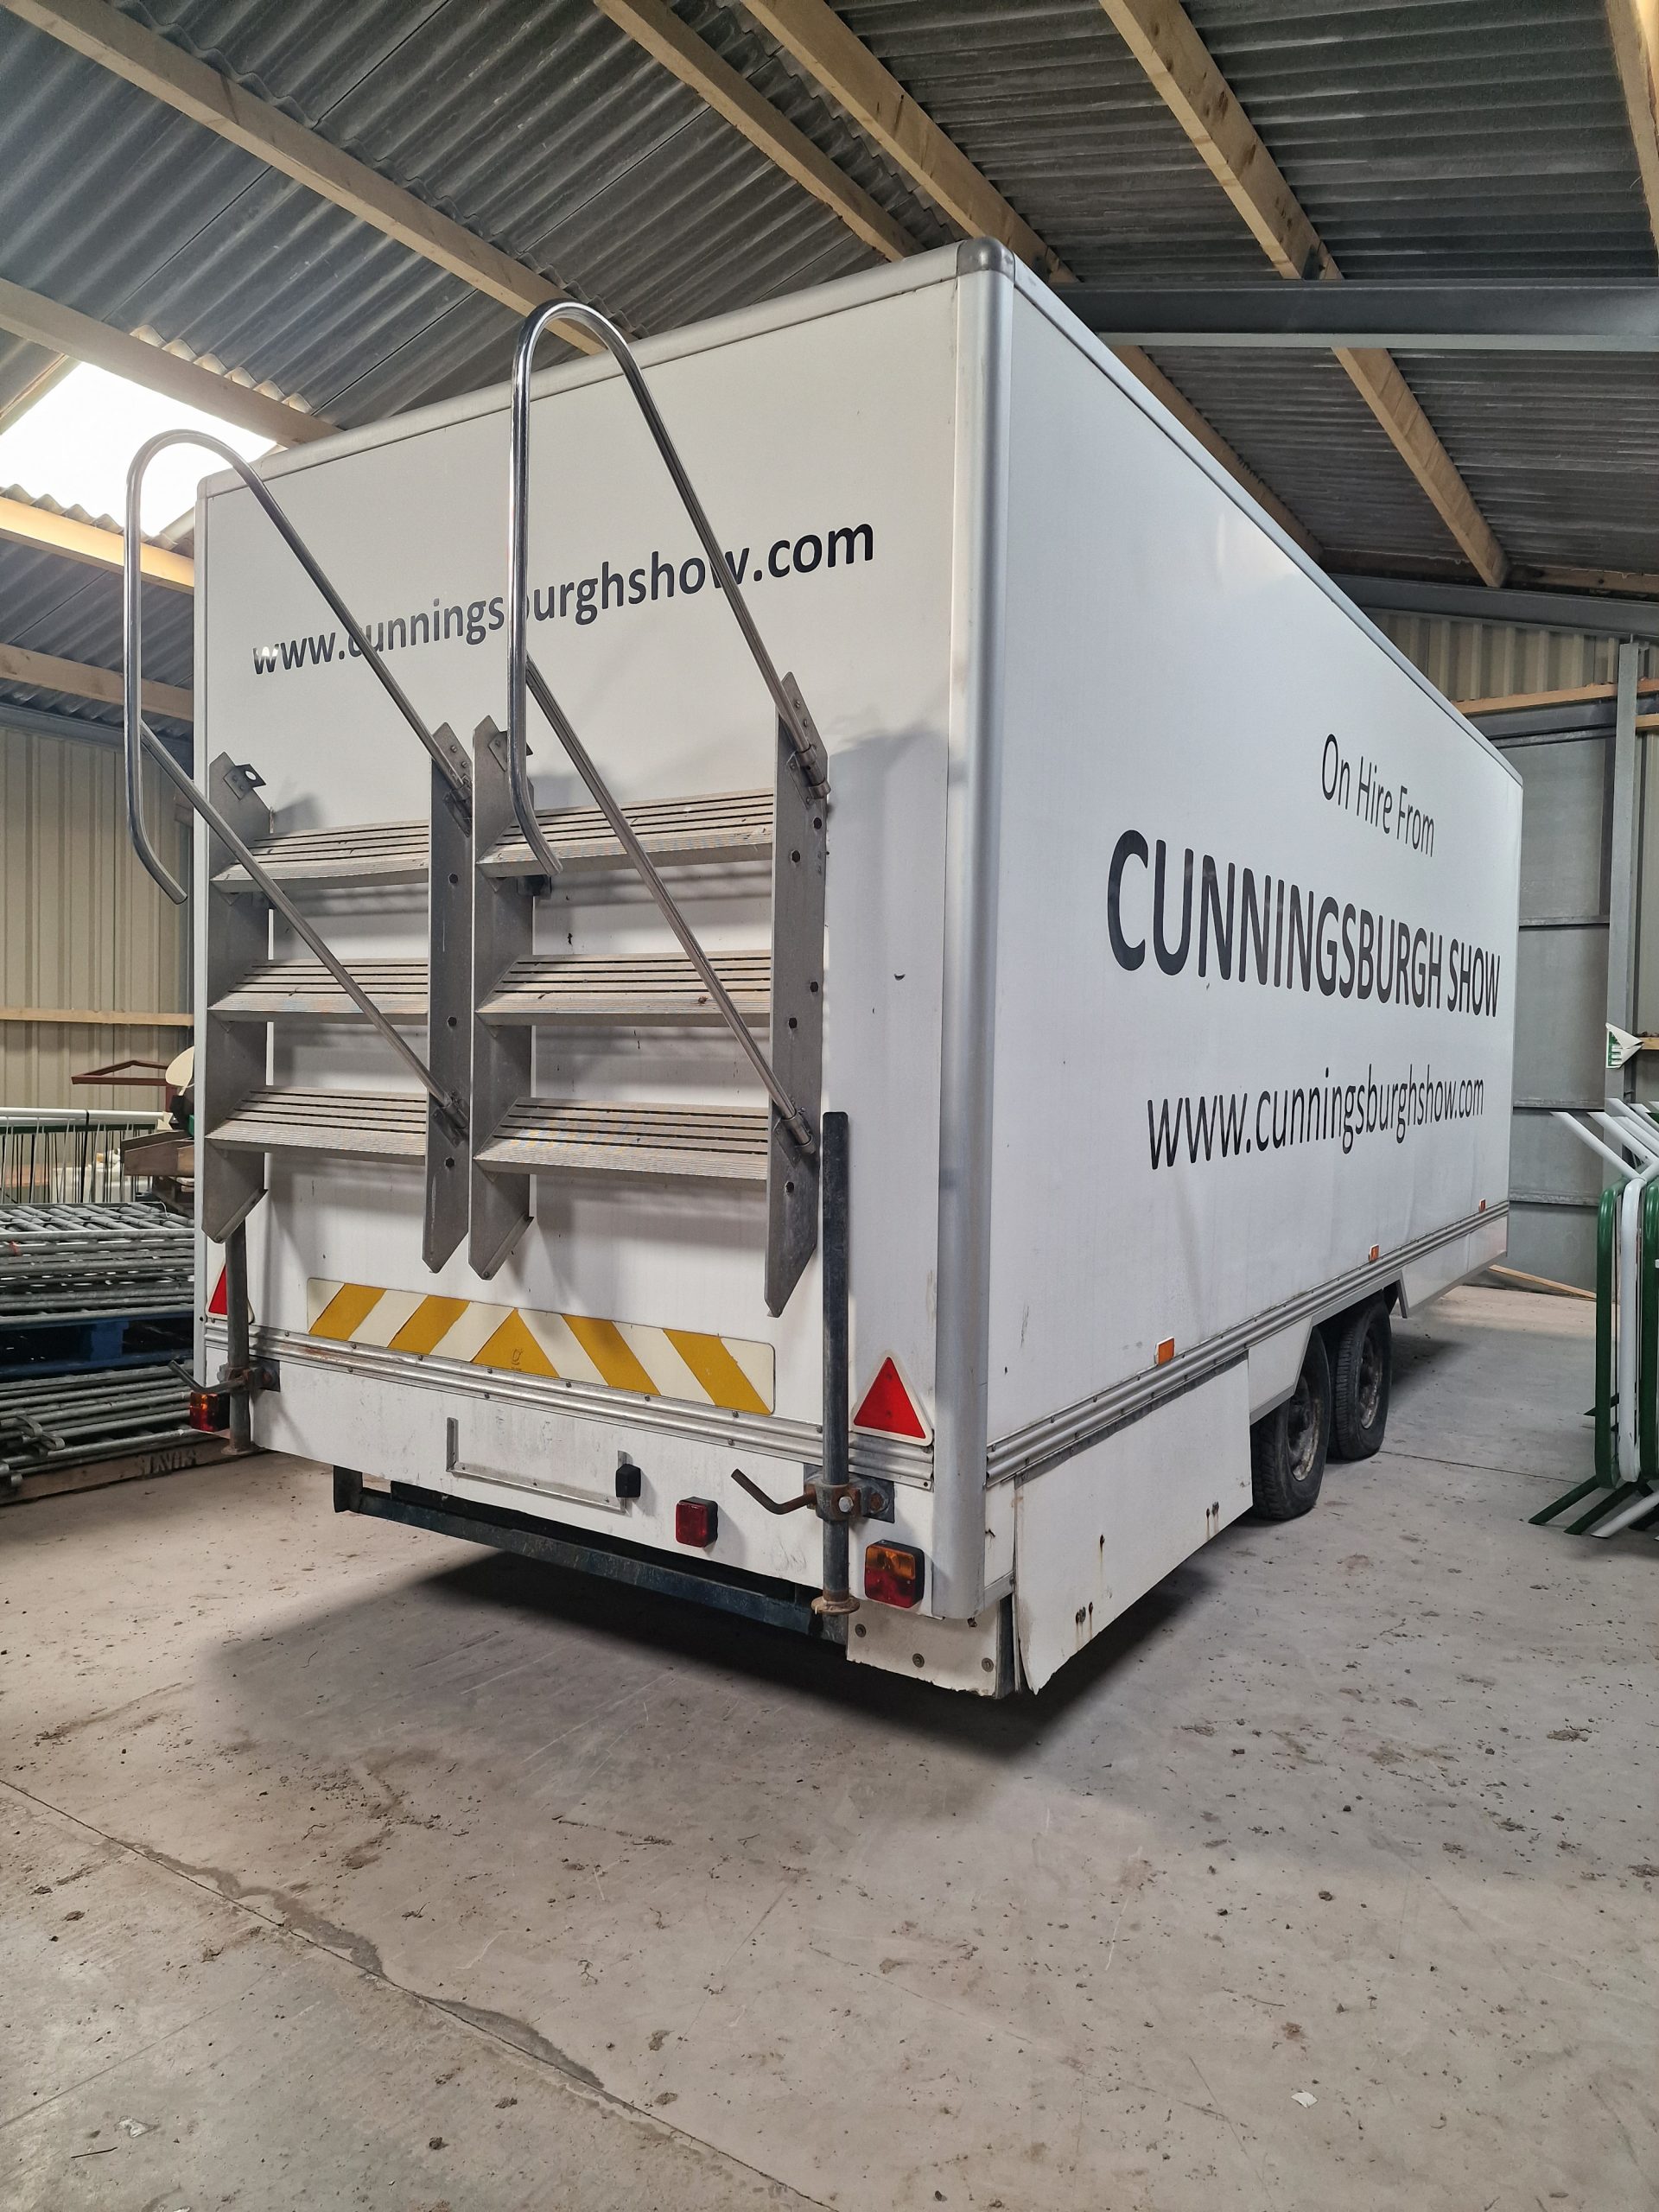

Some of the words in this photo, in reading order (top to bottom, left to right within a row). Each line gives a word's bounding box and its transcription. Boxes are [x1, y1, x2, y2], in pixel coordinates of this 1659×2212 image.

[253, 522, 874, 675] www.cunningsurghshow.com
[1322, 734, 1351, 810] On
[1357, 756, 1393, 835] Hire
[1396, 785, 1434, 858] From
[1107, 830, 1443, 1010] CUNNINGSBURGH
[1447, 939, 1501, 1018] SHOW
[1147, 1064, 1484, 1171] www.cunningsburghshow.com
